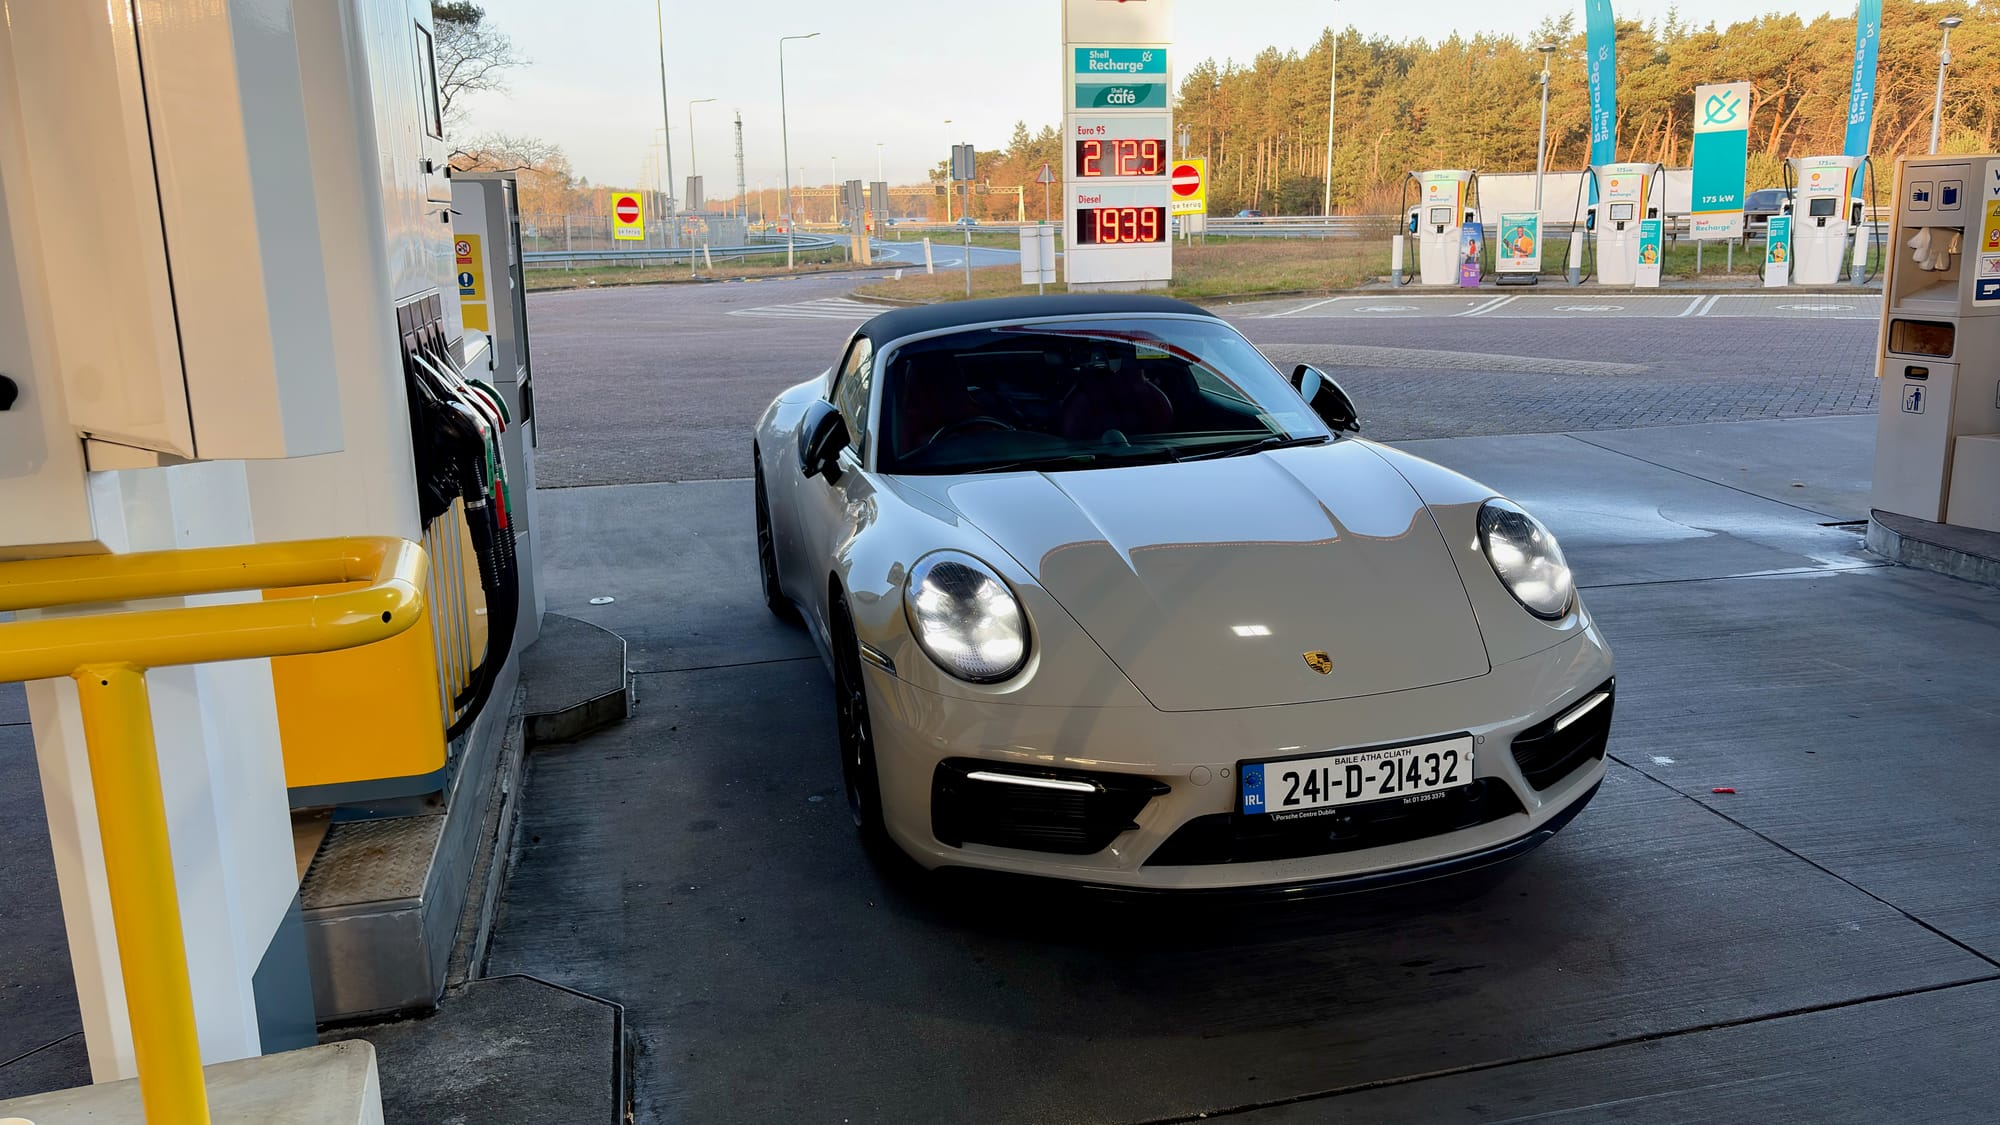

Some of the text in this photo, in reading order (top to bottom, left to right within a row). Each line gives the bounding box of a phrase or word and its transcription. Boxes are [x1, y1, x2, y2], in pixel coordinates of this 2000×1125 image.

[1089, 51, 1109, 59] Shell
[1089, 59, 1144, 73] Recharge
[1107, 90, 1136, 104] café
[1077, 126, 1105, 135] Euro 95
[1084, 140, 1159, 176] 212.9
[1078, 194, 1102, 204] Diesel
[1702, 195, 1735, 204] 175 kW
[1182, 201, 1202, 209] terug
[1093, 208, 1158, 243] 193.9
[1695, 224, 1731, 232] Recharge
[1334, 756, 1359, 765] BAILE
[1383, 749, 1412, 759] CLIATH
[1282, 750, 1458, 806] 241-D-21432
[1244, 794, 1263, 806] IRL
[1275, 813, 1299, 821] Porsche
[1298, 811, 1318, 819] Centre
